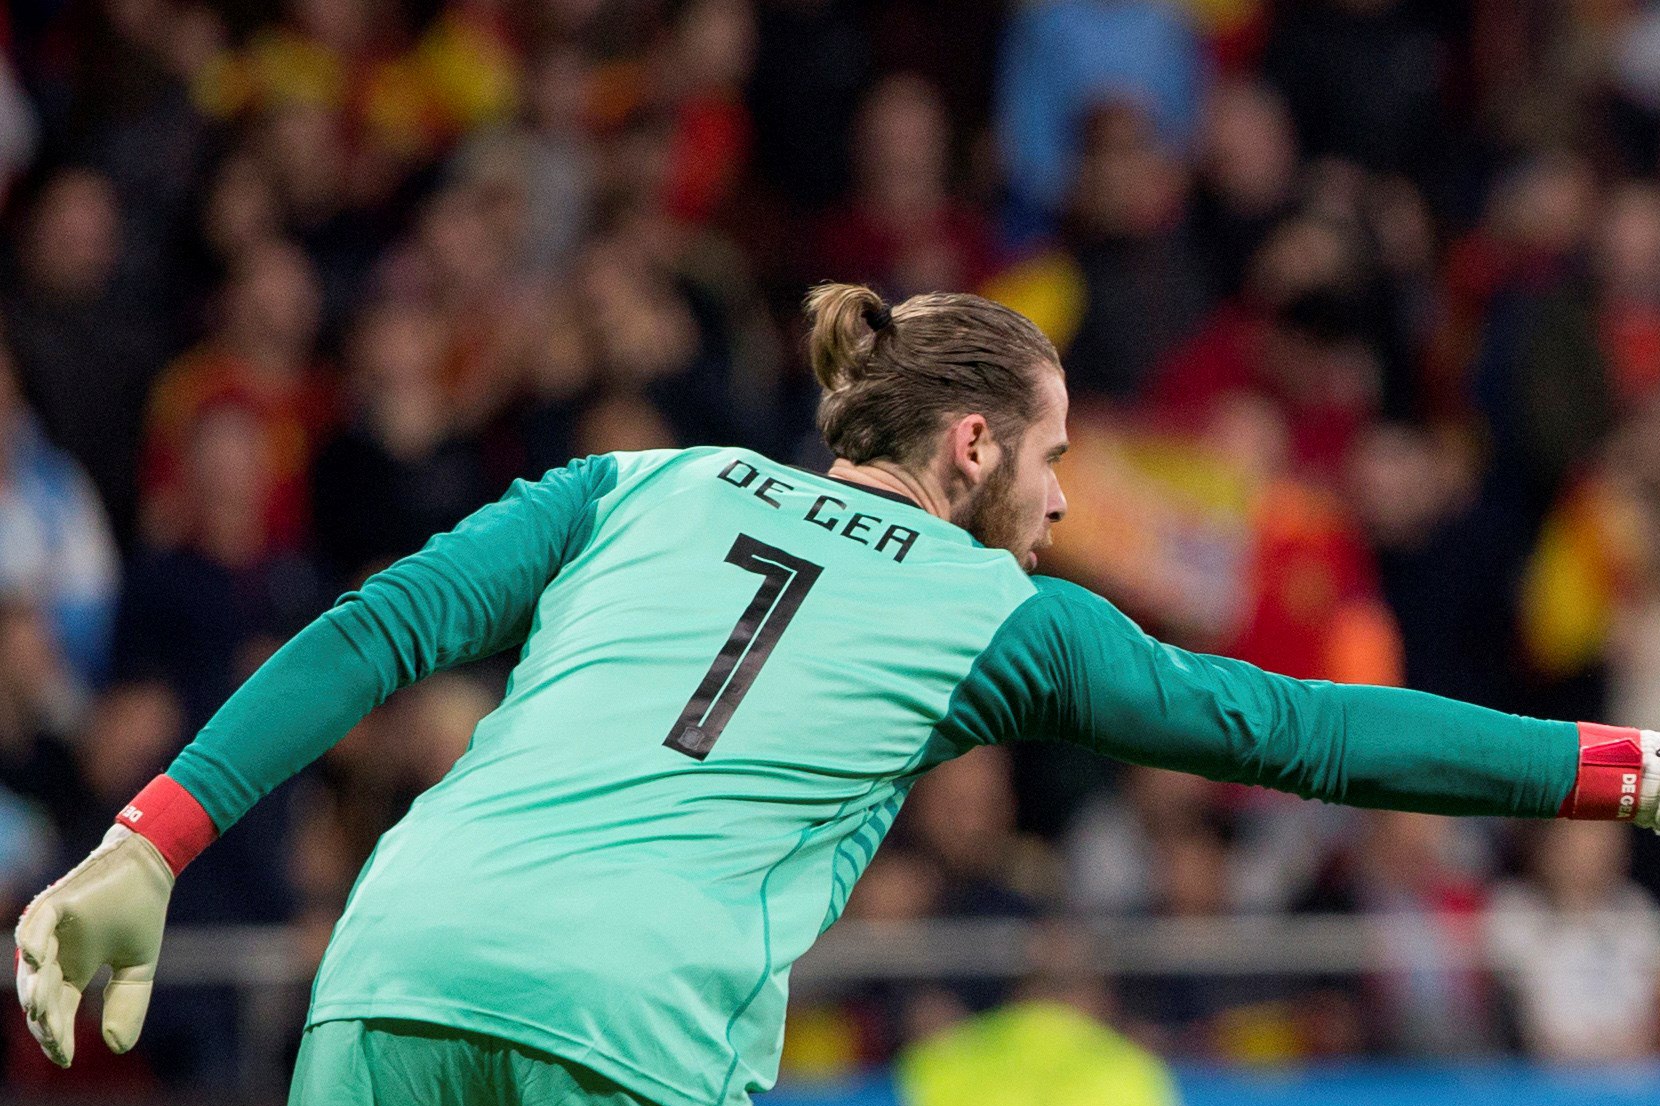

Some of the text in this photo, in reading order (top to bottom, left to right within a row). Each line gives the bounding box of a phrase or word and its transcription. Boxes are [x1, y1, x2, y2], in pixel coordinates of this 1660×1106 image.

[716, 459, 921, 564] DE GEA
[1621, 773, 1637, 793] DE
